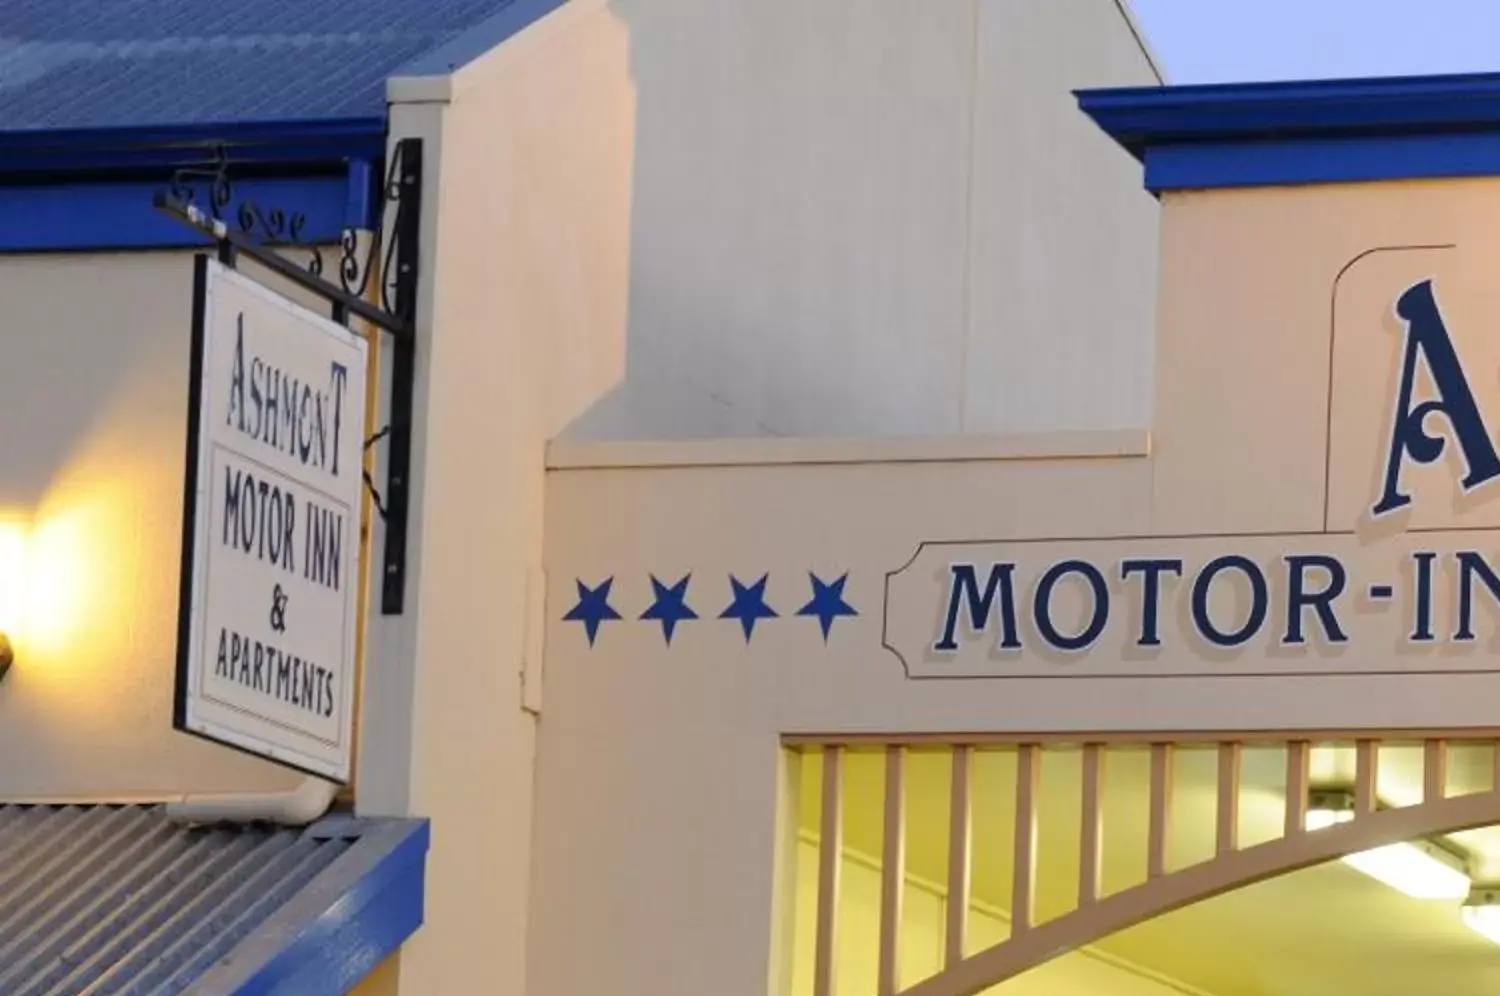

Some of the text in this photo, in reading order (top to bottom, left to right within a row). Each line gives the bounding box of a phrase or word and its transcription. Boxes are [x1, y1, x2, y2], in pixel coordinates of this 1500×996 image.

[227, 312, 347, 475] ASHMONT
[223, 465, 341, 592] MOTOR INN
[269, 583, 289, 633] &
[215, 628, 334, 718] APARTMENTS
